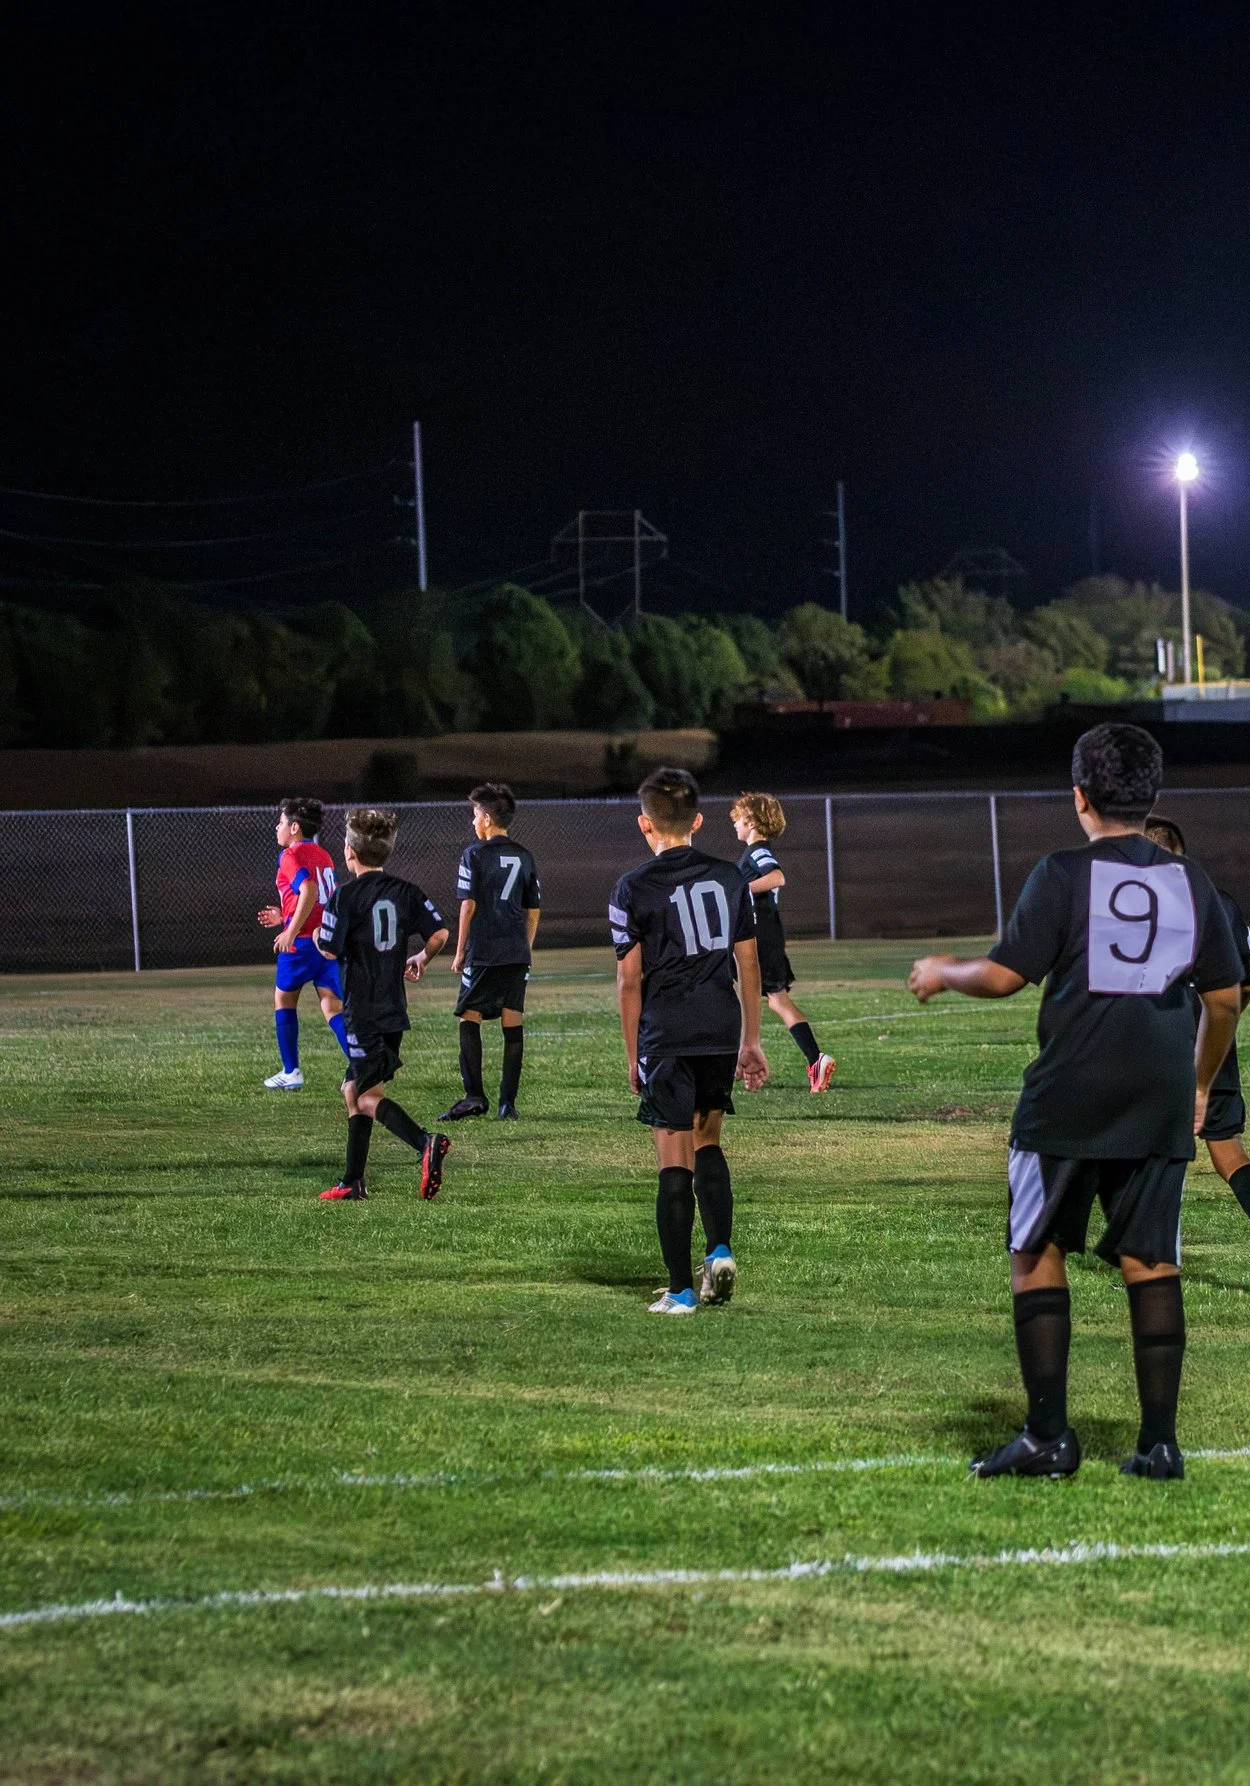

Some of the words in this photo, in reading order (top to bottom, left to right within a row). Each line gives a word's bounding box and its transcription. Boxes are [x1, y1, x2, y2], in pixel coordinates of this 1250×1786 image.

[499, 855, 522, 901] 7
[668, 880, 730, 956] 10
[1108, 879, 1159, 965] 9
